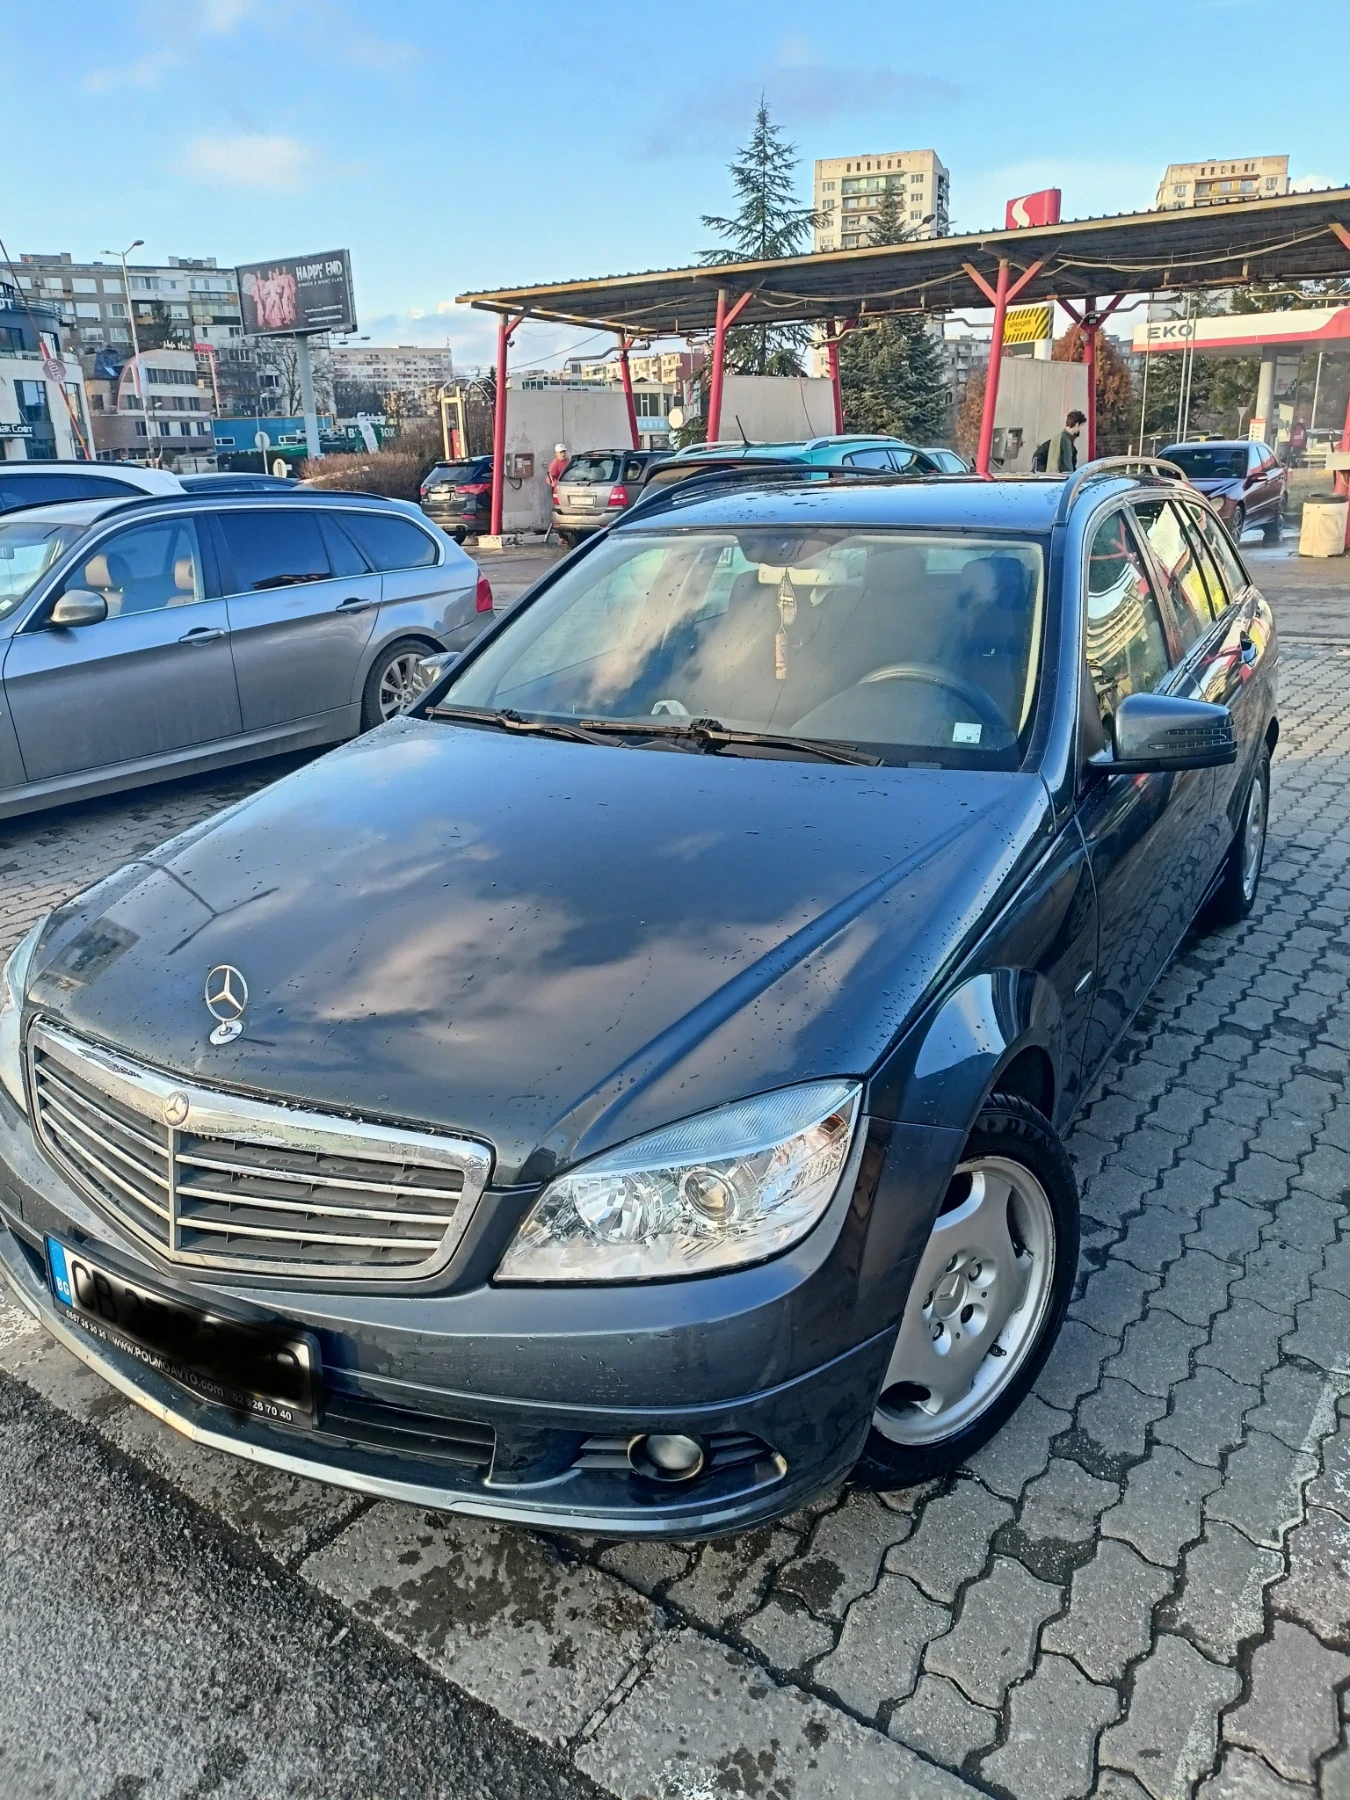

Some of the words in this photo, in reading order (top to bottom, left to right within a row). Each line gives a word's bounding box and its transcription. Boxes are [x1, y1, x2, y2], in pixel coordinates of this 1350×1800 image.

[296, 263, 323, 281] HAPPY
[325, 260, 342, 275] END
[1147, 324, 1192, 338] EKO
[47, 361, 62, 381] STOP
[56, 1276, 70, 1296] BG
[265, 1403, 278, 1416] 70
[280, 1409, 292, 1421] 40
